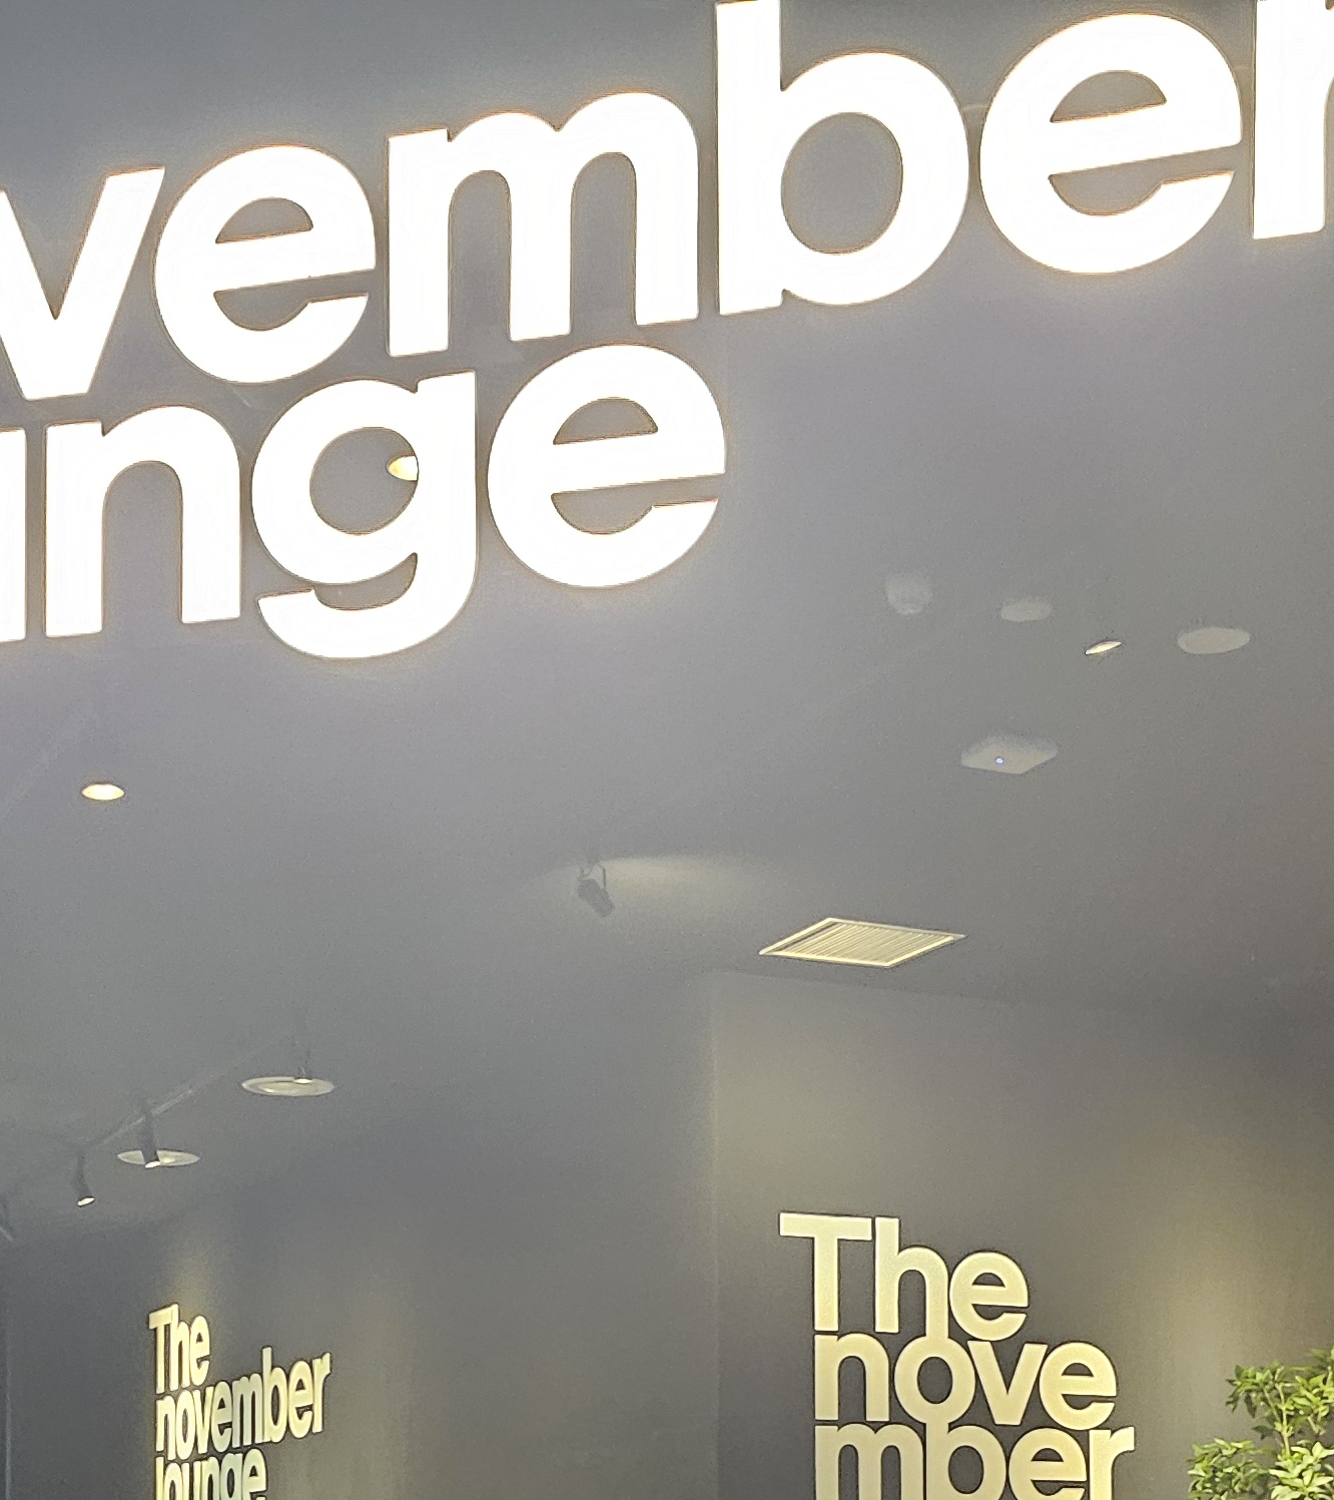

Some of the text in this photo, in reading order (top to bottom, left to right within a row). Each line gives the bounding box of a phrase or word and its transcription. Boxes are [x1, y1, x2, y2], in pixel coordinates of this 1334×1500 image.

[779, 1212, 1029, 1342] The
[148, 1303, 210, 1394] The
[814, 1334, 1117, 1431] nove
[155, 1346, 331, 1461] november
